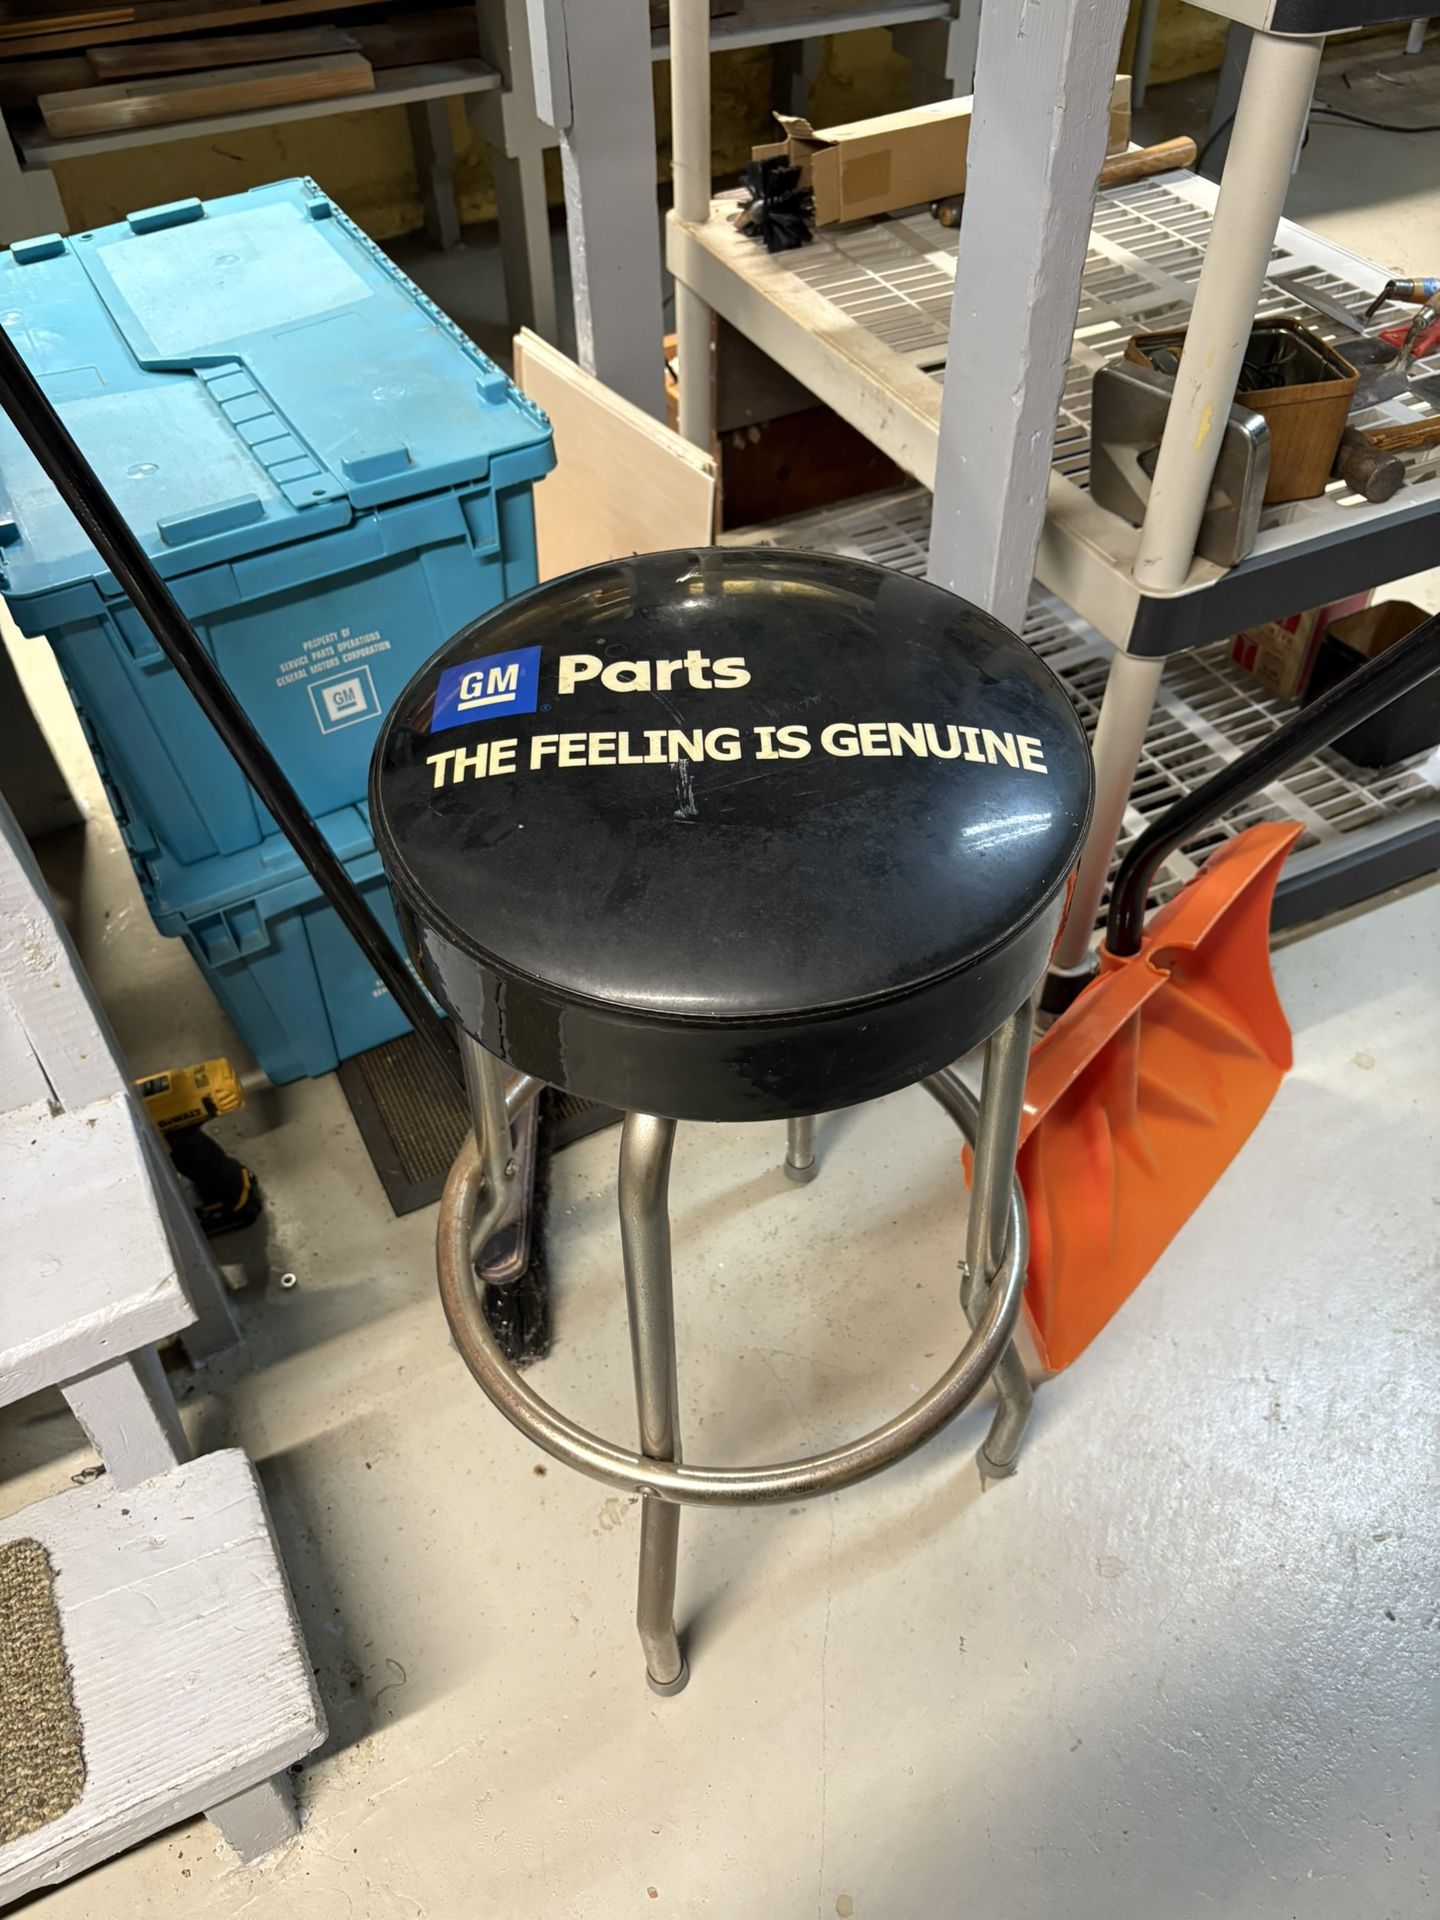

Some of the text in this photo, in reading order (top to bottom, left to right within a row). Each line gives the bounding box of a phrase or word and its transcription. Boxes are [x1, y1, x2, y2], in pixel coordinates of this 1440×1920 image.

[280, 631, 381, 673] SERVICE PARTS OPERATIONS
[303, 627, 350, 651] PROPERTY OF
[276, 640, 391, 687] GENERAL MOTORS CORPORATION
[459, 650, 751, 700] GM Parts
[333, 687, 356, 706] GM
[426, 722, 1048, 789] THE FEELING IS GENUINE
